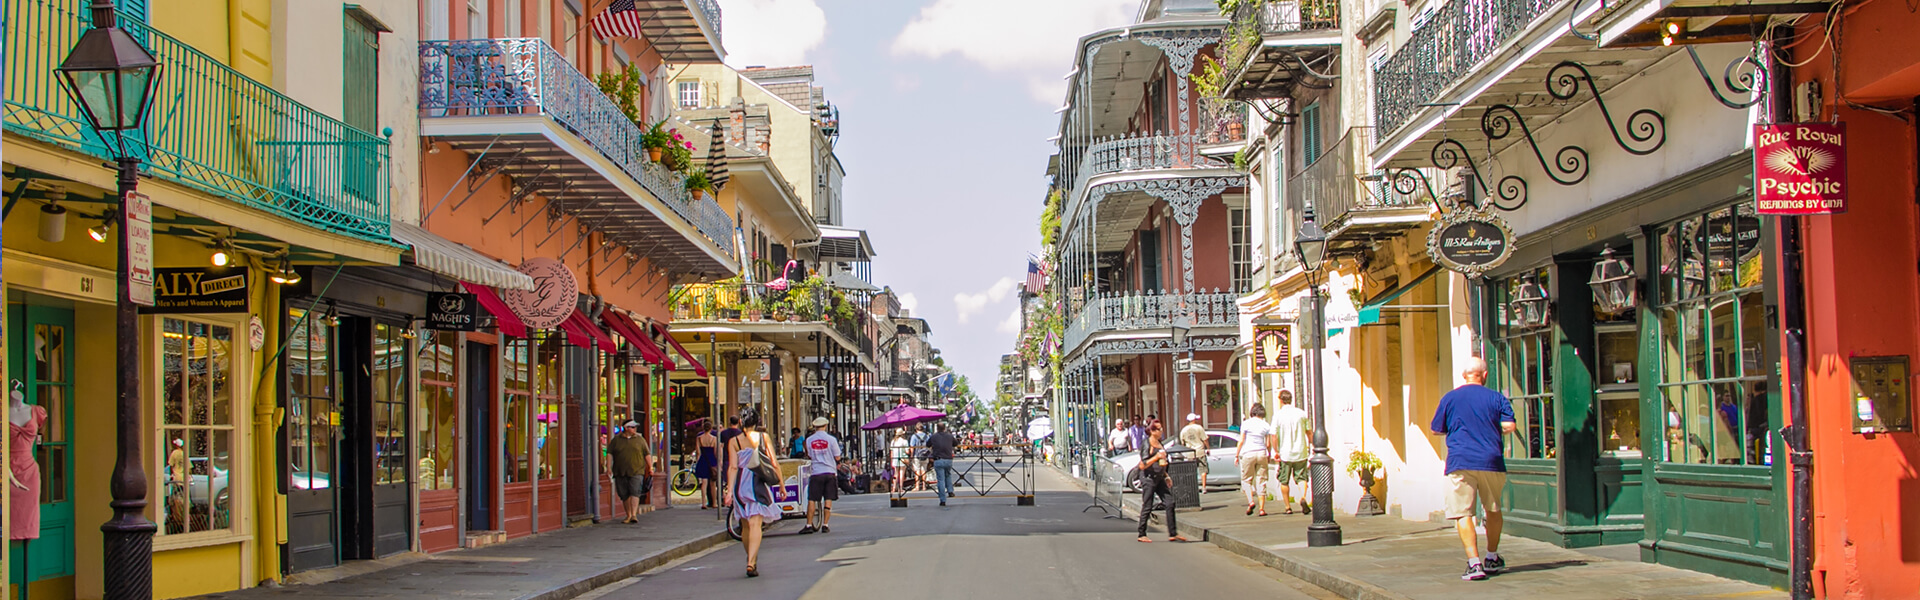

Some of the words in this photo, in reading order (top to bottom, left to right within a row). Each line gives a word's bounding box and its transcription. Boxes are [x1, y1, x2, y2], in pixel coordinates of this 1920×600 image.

[1759, 131, 1791, 148] Rue
[1796, 127, 1842, 147] Royal
[1760, 177, 1841, 198] Psychic
[1760, 200, 1804, 210] READINGS
[1805, 199, 1820, 209] BY
[1821, 199, 1843, 209] GINA
[131, 226, 150, 240] LOADING
[135, 242, 147, 256] ZONE
[81, 277, 94, 293] 631
[204, 278, 242, 293] DIRECT
[157, 299, 176, 307] Men's
[177, 299, 189, 307] and
[189, 299, 218, 307] Women's
[219, 298, 245, 308] Apparel
[431, 312, 471, 324] NAGHI'S
[512, 306, 537, 327] FISCHER
[541, 307, 571, 328] GAMBINO
